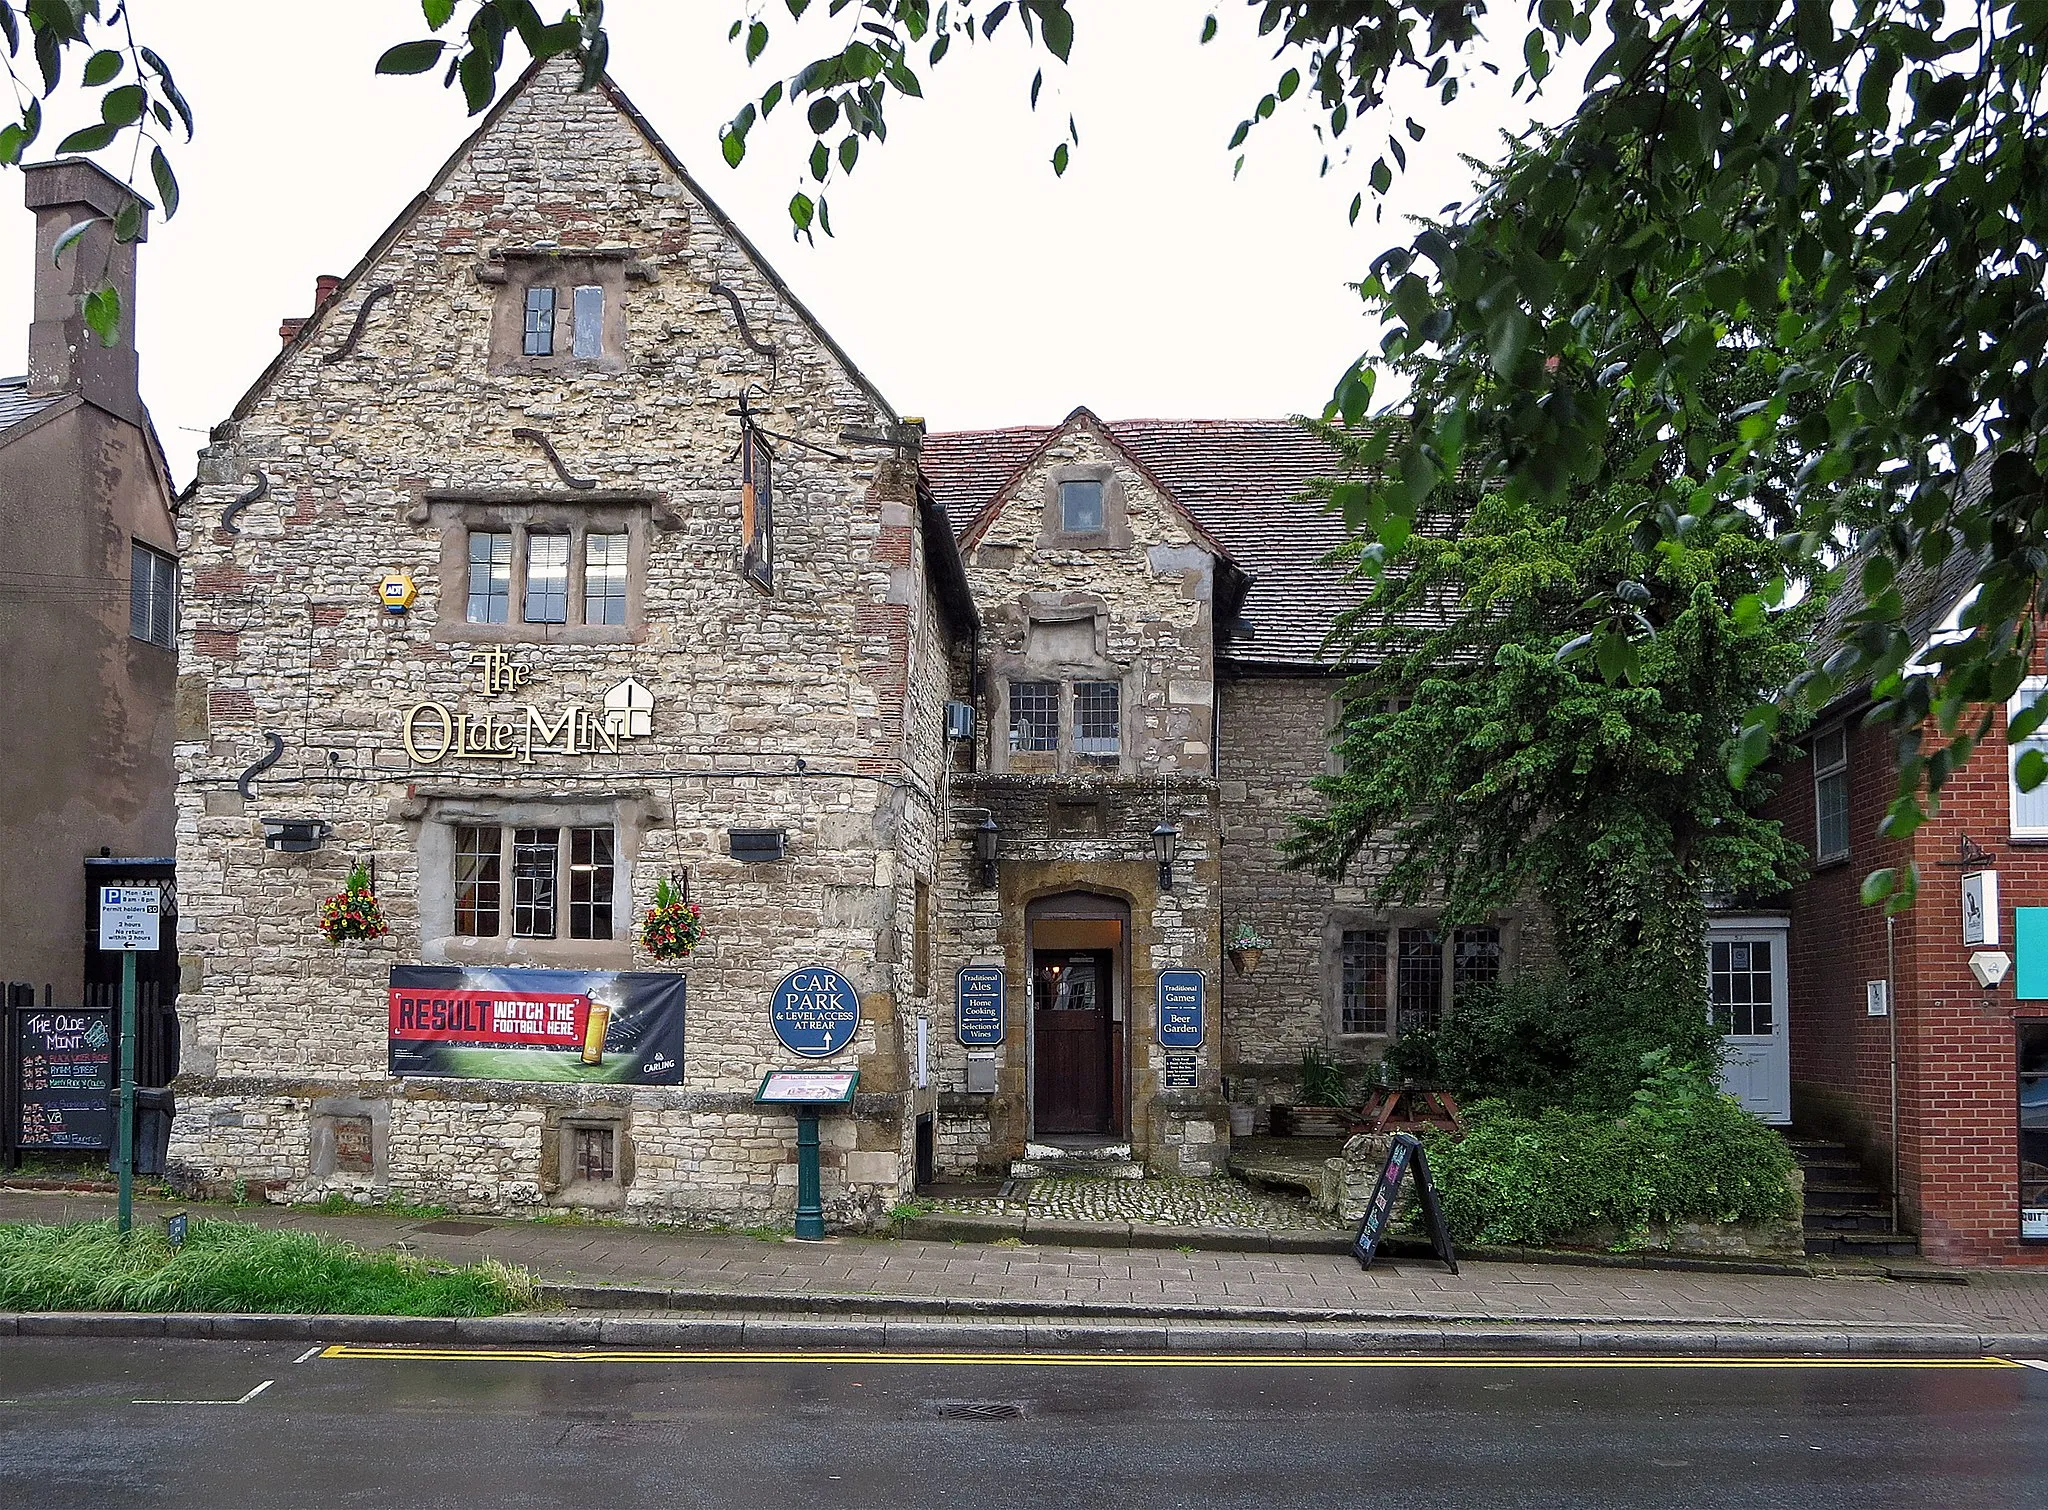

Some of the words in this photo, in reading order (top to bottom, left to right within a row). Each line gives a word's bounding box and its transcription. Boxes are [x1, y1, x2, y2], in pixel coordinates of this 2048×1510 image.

[386, 584, 402, 596] ADT
[469, 644, 530, 698] The
[109, 890, 119, 902] P
[792, 975, 838, 991] CAR
[970, 982, 991, 991] Ales
[786, 994, 844, 1010] PARK
[1166, 994, 1196, 1002] Games
[400, 999, 491, 1032] RESULT
[494, 1001, 544, 1021] WATCH
[550, 1003, 574, 1021] THE
[965, 1007, 996, 1016] Cooking
[28, 1014, 51, 1034] THE
[56, 1015, 85, 1031] OLDE
[1171, 1015, 1190, 1023] Beer
[493, 1020, 544, 1035] FOOTBALL
[547, 1022, 574, 1036] HERE
[1164, 1024, 1197, 1033] Garden
[47, 1034, 82, 1050] MINT
[643, 1060, 675, 1073] CARLING
